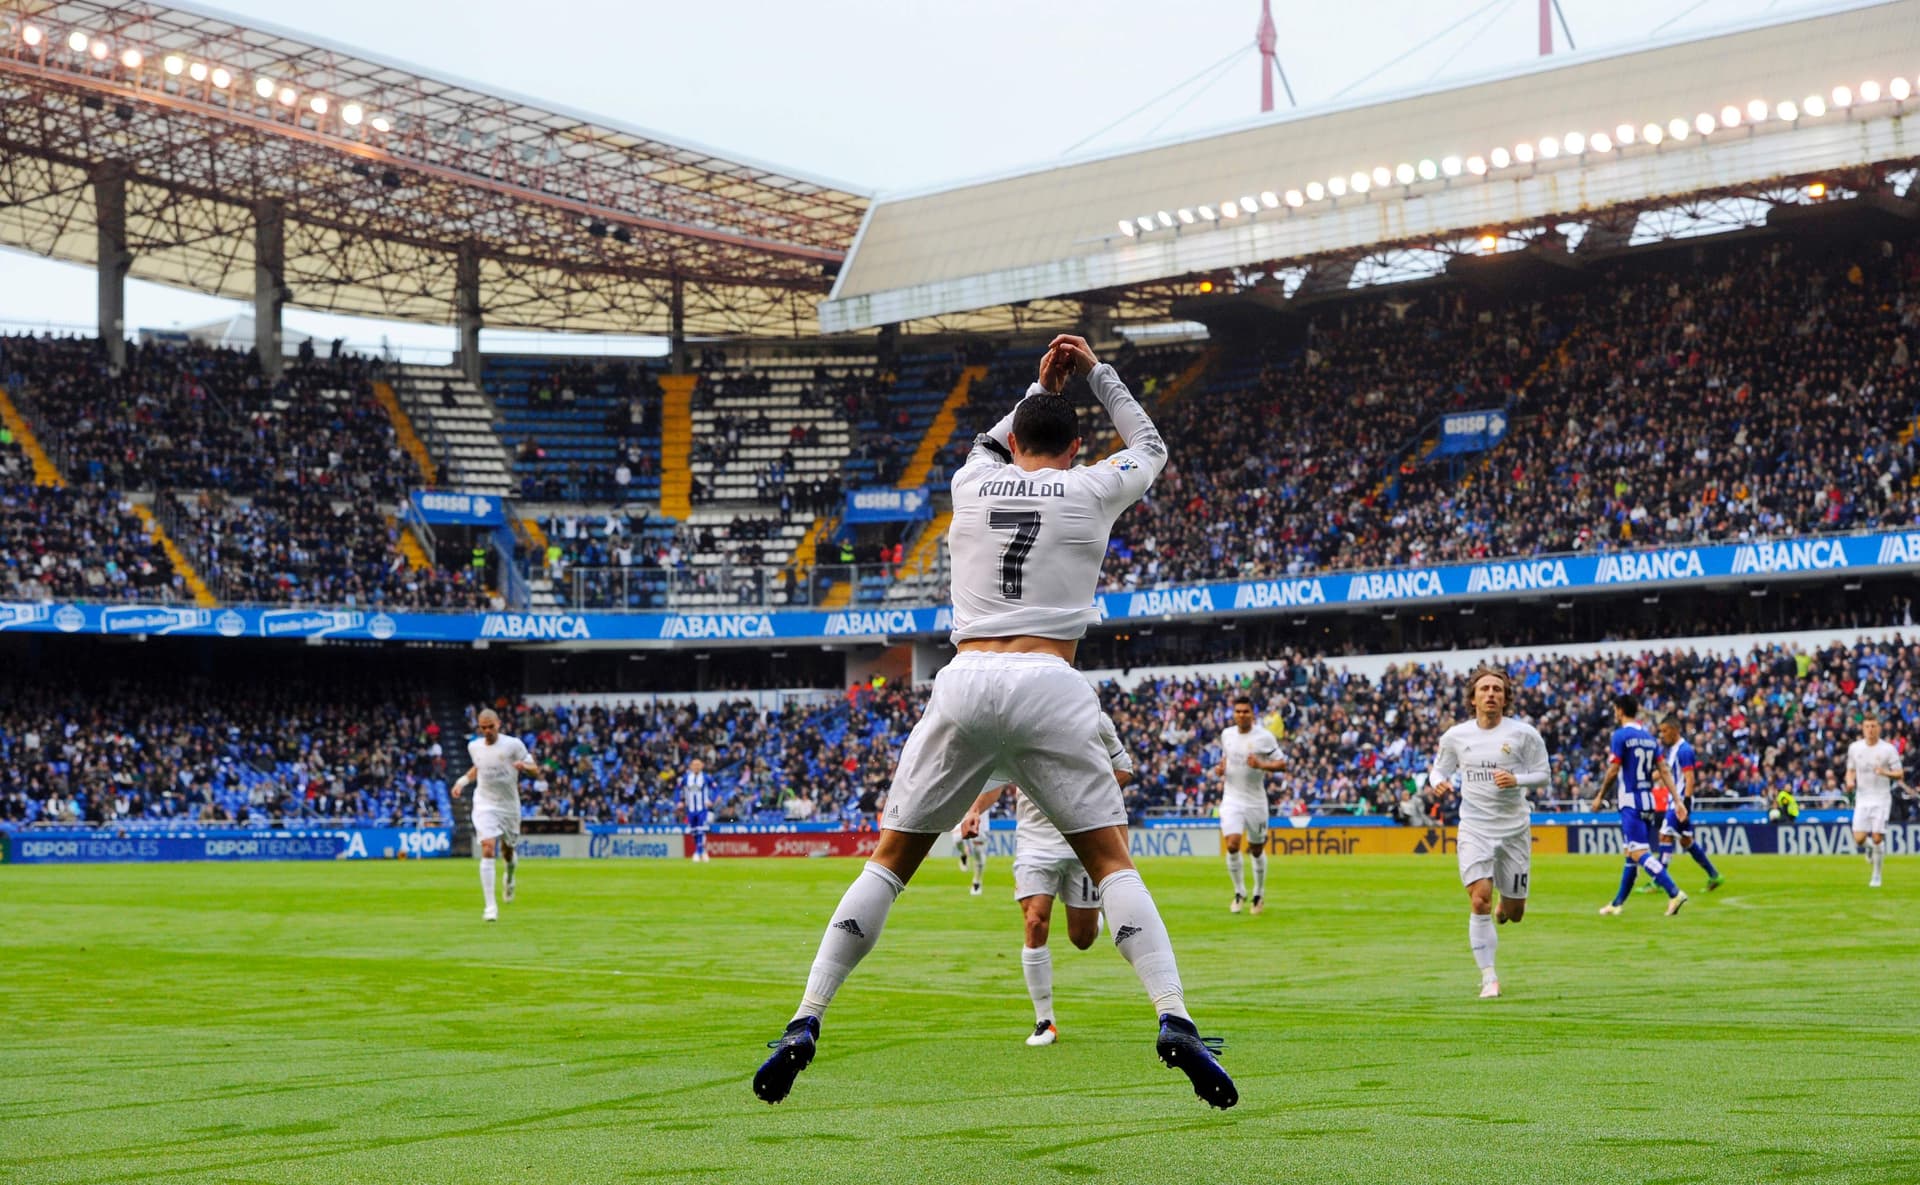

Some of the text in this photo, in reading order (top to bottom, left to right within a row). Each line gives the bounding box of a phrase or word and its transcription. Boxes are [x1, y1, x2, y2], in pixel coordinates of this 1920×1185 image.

[978, 480, 1065, 497] RONALDO
[986, 508, 1041, 599] 7
[1467, 768, 1497, 782] Emir
[1634, 748, 1654, 780] 21
[22, 841, 159, 857] DEPORTIENDA.ES
[205, 839, 335, 855] DEPORTIENDA.ES
[399, 832, 450, 853] 1906
[1131, 830, 1192, 856] ANCA
[1271, 829, 1361, 855] betfair
[1672, 826, 1752, 855] BVA
[1778, 825, 1858, 854] BBVA
[1513, 873, 1528, 894] 19
